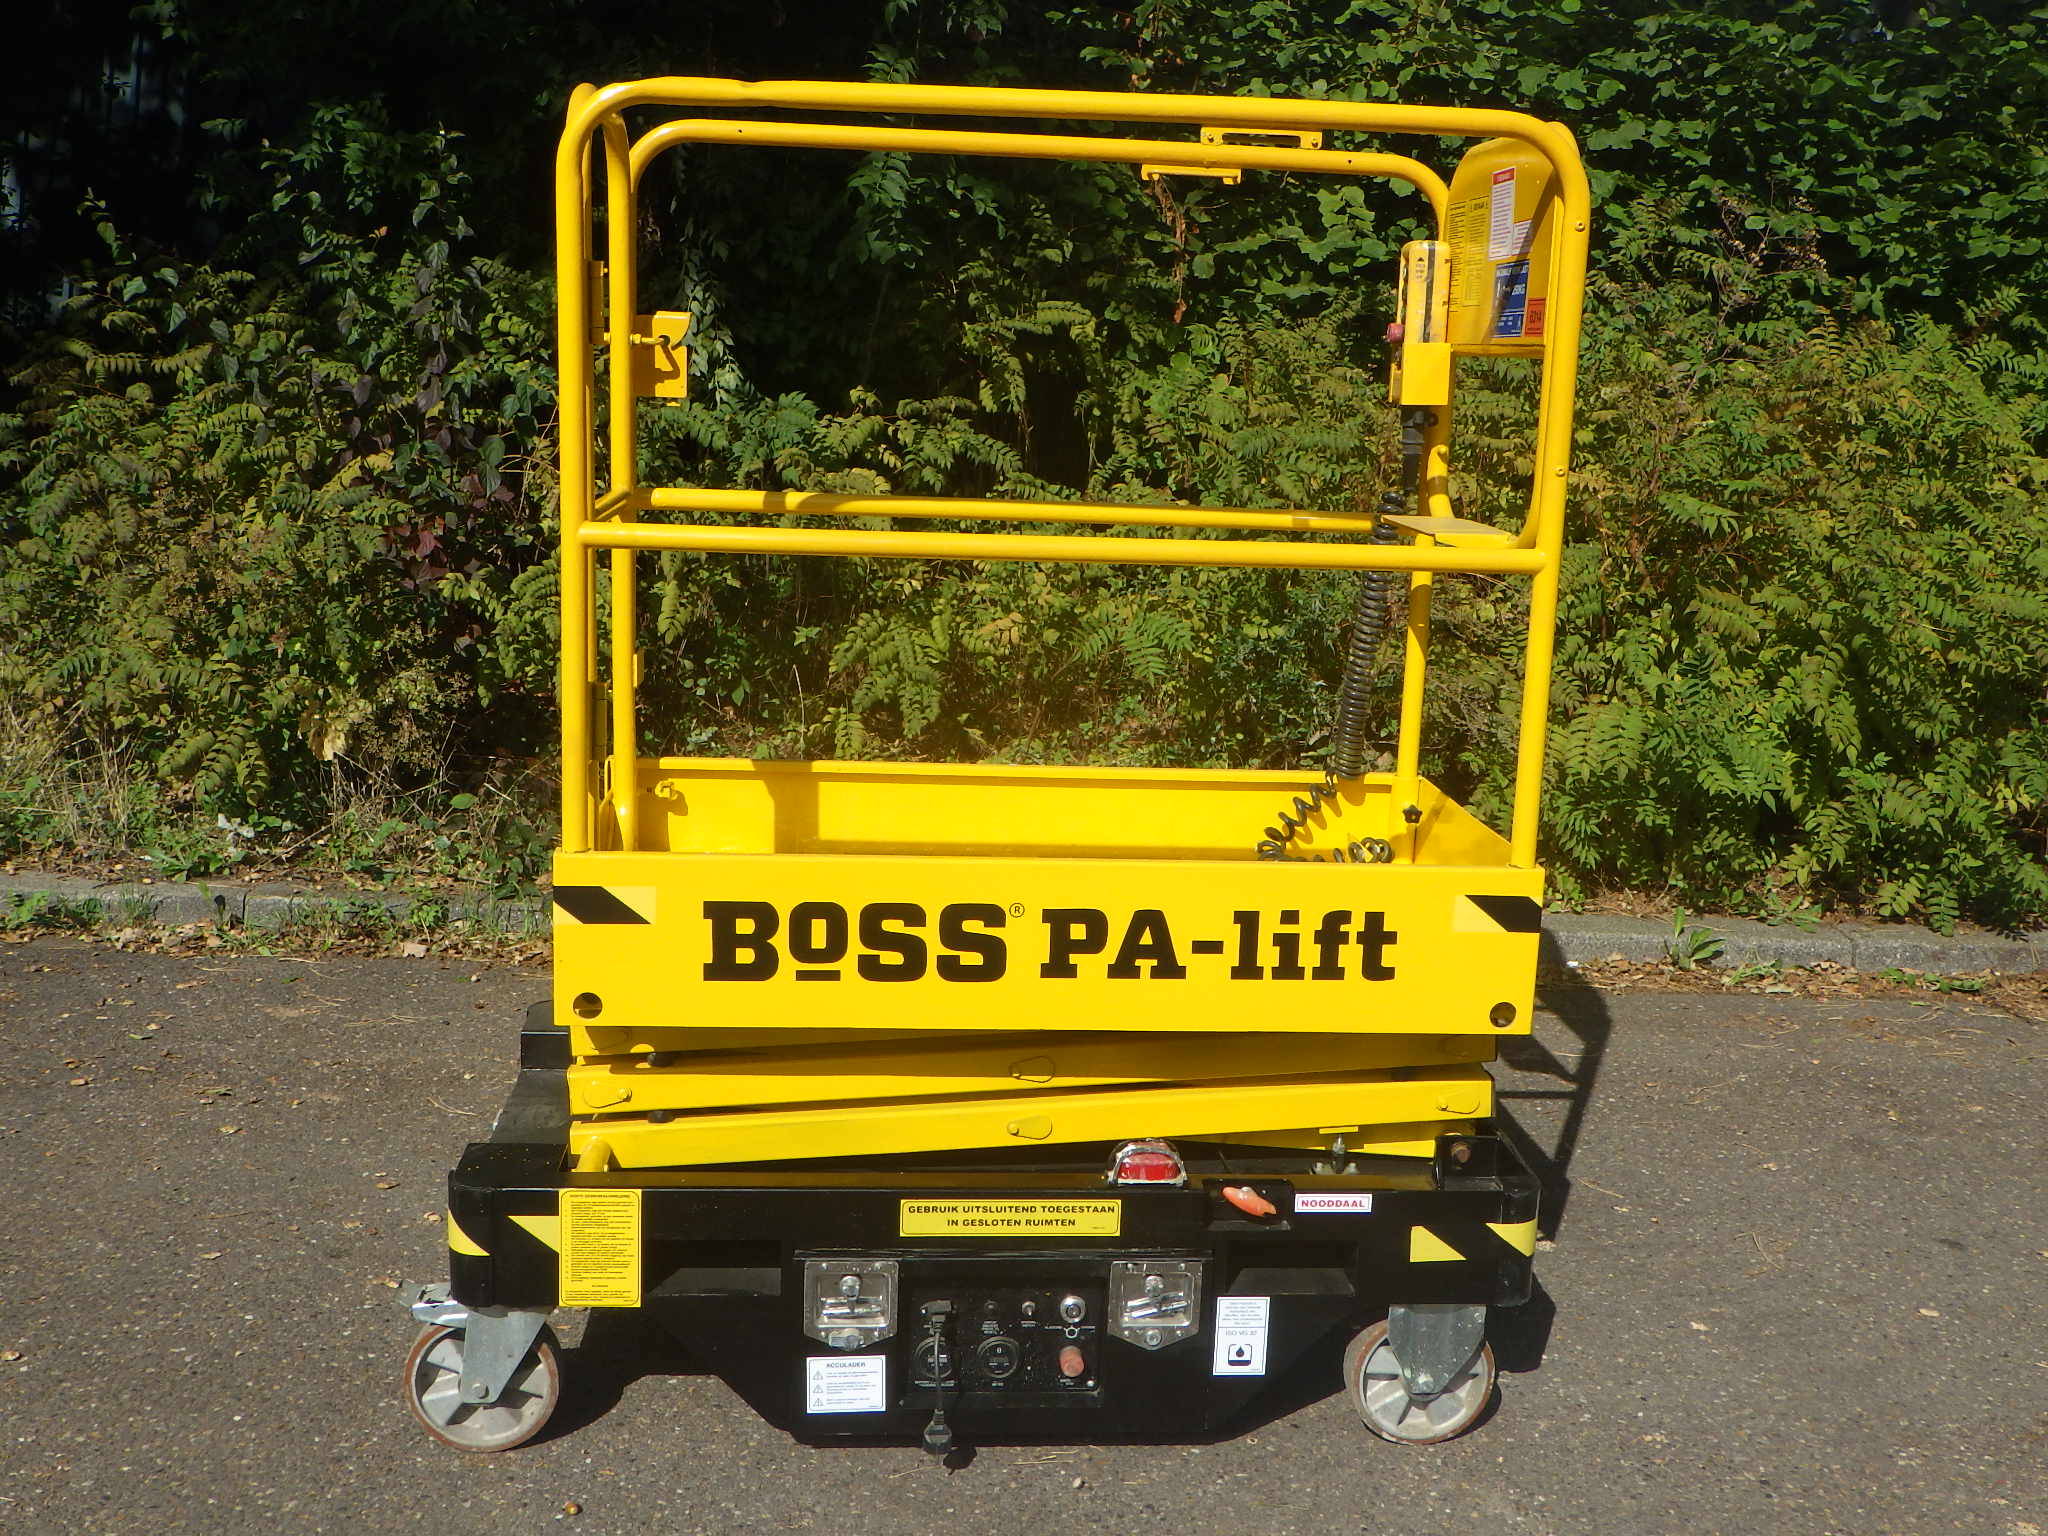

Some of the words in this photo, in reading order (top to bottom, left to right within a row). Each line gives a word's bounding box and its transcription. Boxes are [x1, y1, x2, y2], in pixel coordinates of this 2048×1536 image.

[1039, 908, 1399, 982] PA-lift
[1301, 1199, 1366, 1208] NOODDAAL
[908, 1205, 959, 1214] GEBRUIK
[962, 1205, 1037, 1214] UITSLUITEND
[1040, 1205, 1116, 1214] TOEGESTAAN
[947, 1218, 959, 1227] IN
[962, 1218, 1022, 1227] GESLOTEN
[1024, 1218, 1077, 1227] RUIMTEN
